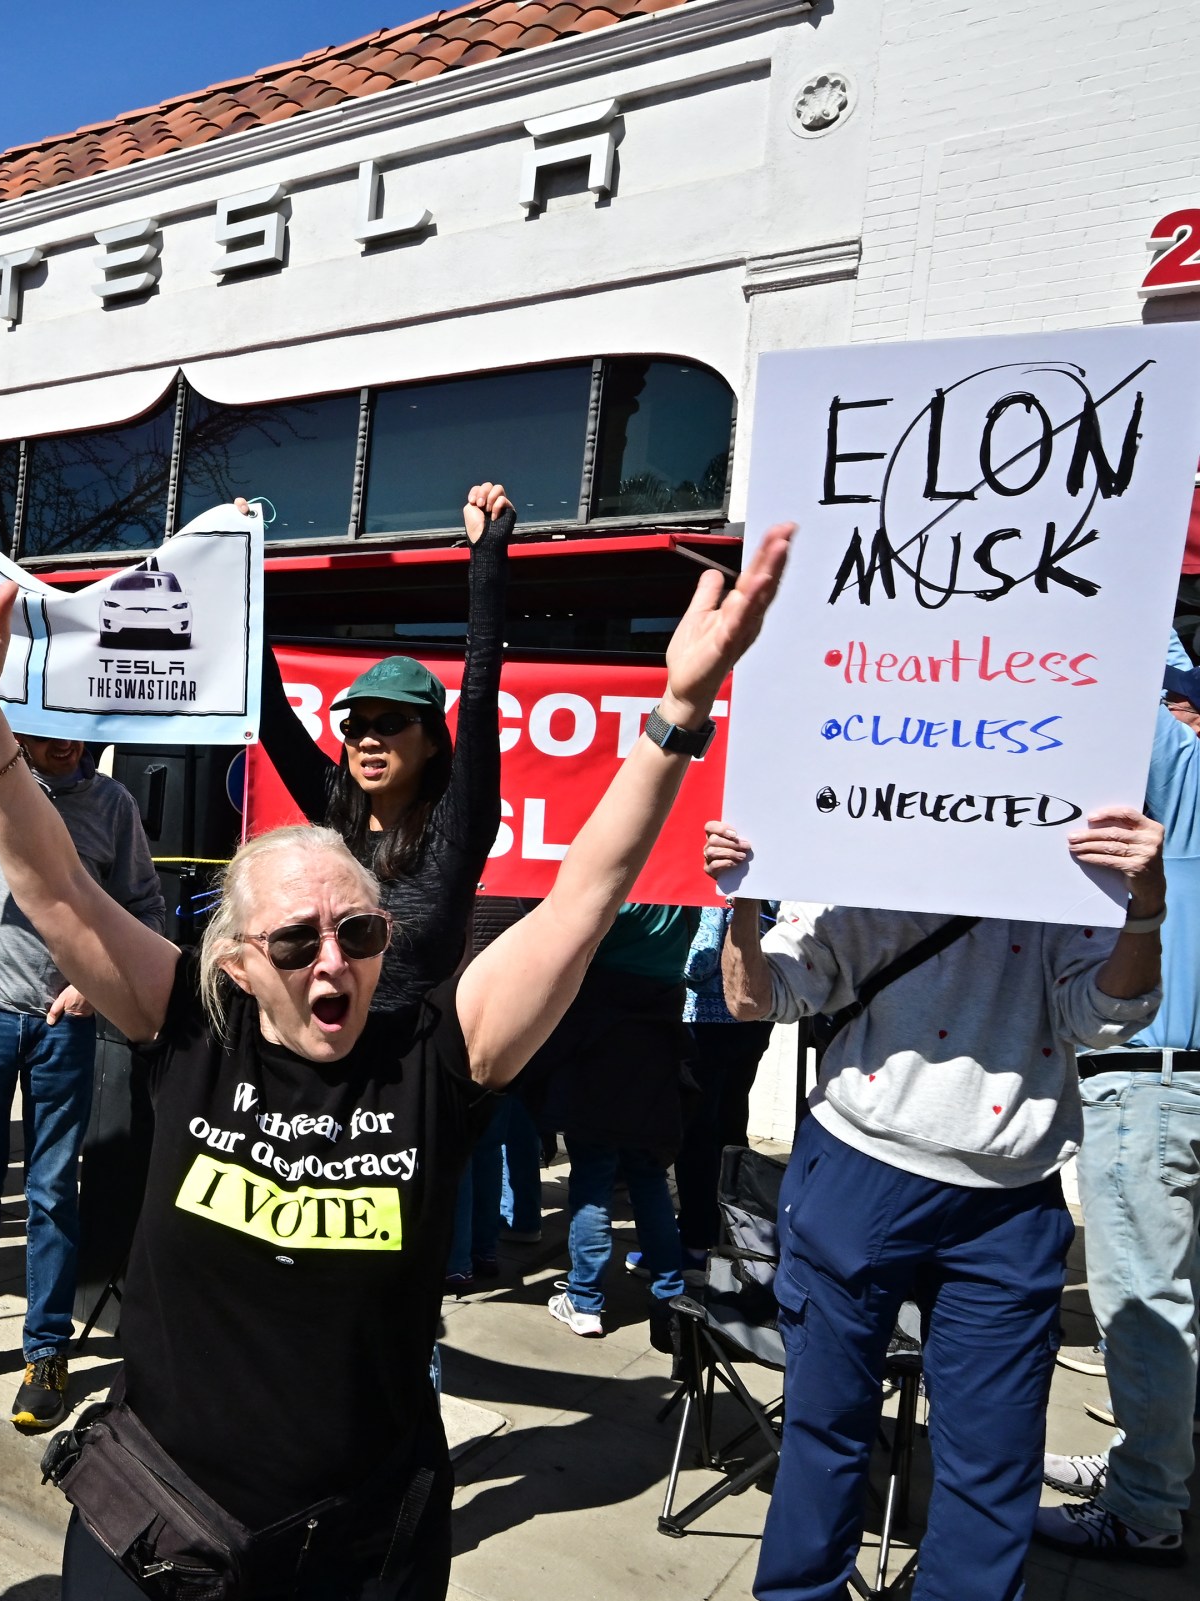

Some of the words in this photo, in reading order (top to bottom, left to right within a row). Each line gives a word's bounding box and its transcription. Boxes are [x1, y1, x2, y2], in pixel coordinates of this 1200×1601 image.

[818, 388, 1144, 505] ELON
[826, 522, 1102, 609] MUSK
[99, 658, 185, 675] TESLA
[843, 714, 1064, 753] CLUELESS
[847, 783, 1083, 828] UNELECTED
[189, 1117, 246, 1154] our
[289, 1113, 343, 1143] fear
[350, 1108, 395, 1140] for
[195, 1168, 229, 1210] I
[242, 1178, 391, 1241] VOTE.
